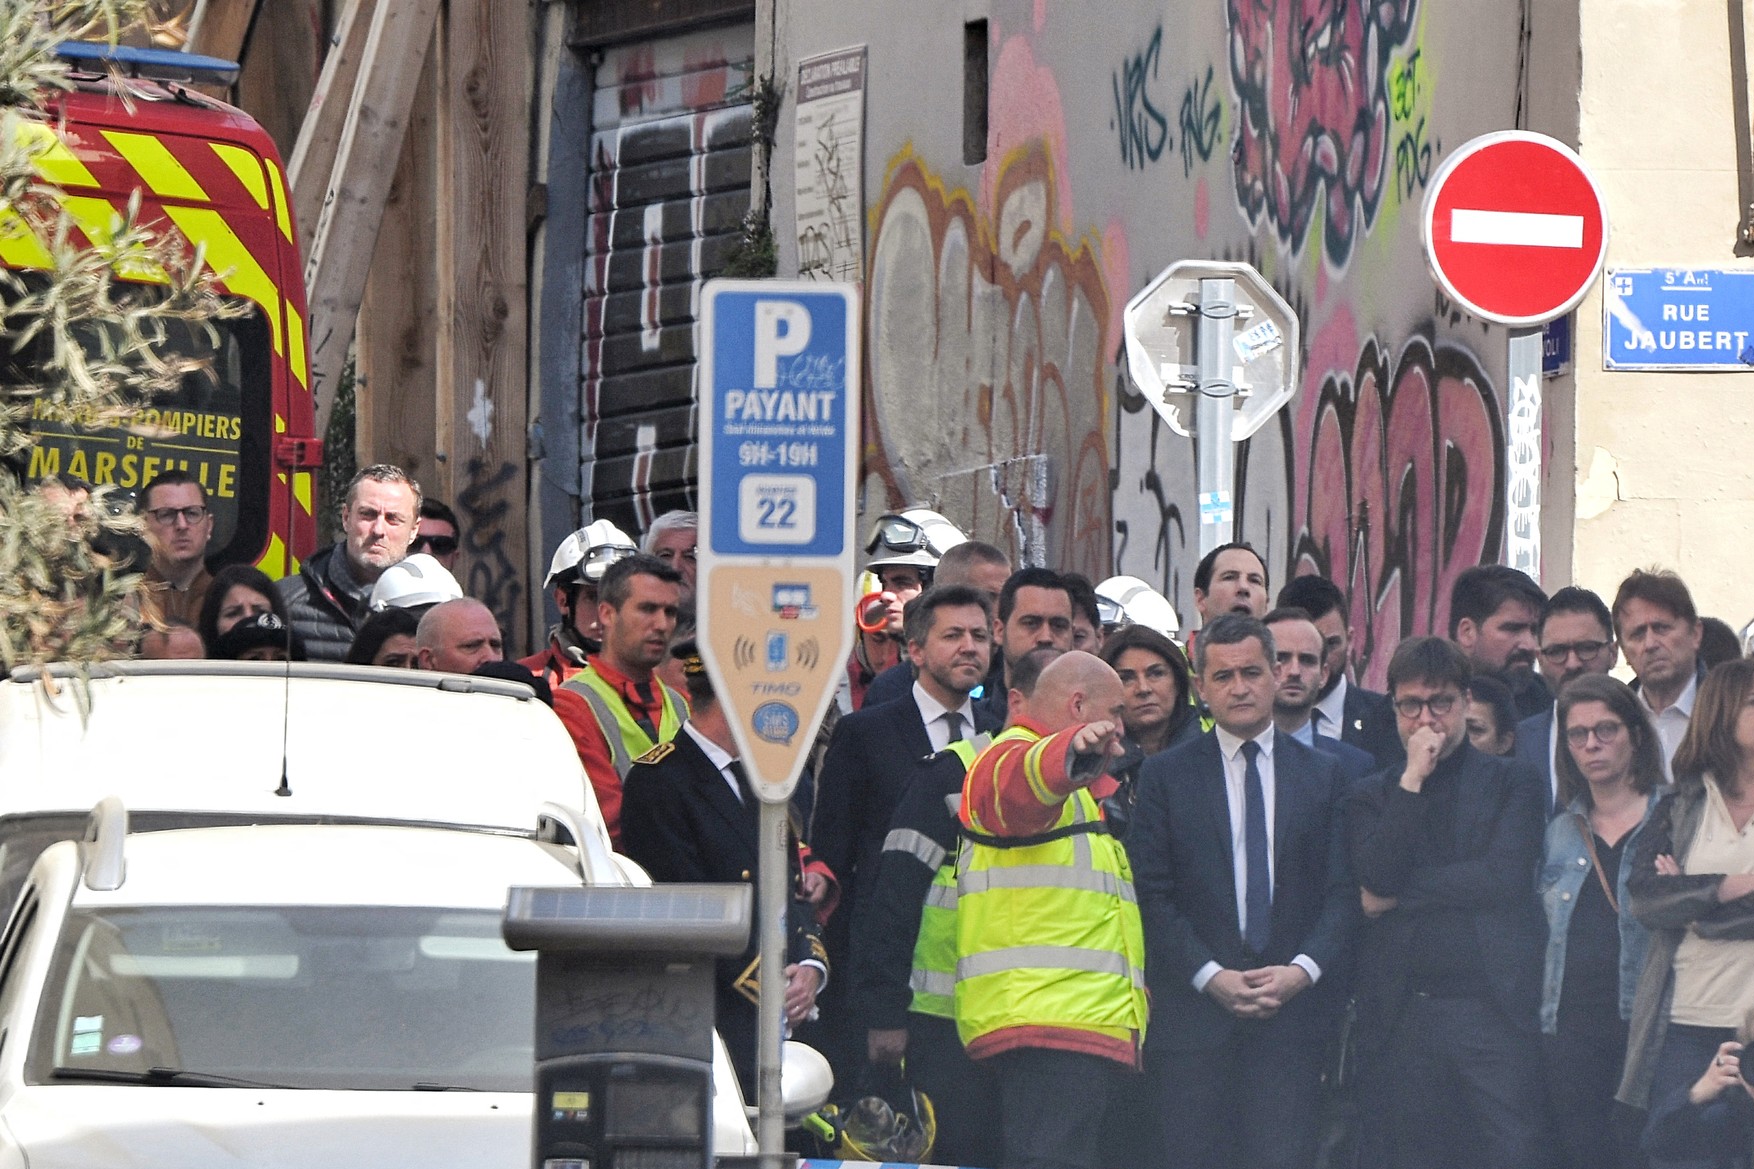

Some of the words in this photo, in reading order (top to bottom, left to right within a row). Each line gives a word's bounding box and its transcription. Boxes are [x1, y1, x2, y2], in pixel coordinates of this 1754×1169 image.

[1663, 304, 1710, 321] RUE
[754, 299, 812, 388] P
[1624, 330, 1749, 350] JAUBERT
[724, 389, 836, 421] PAYANT
[126, 435, 144, 450] DE
[28, 446, 236, 498] MARSELE
[757, 498, 797, 528] 22
